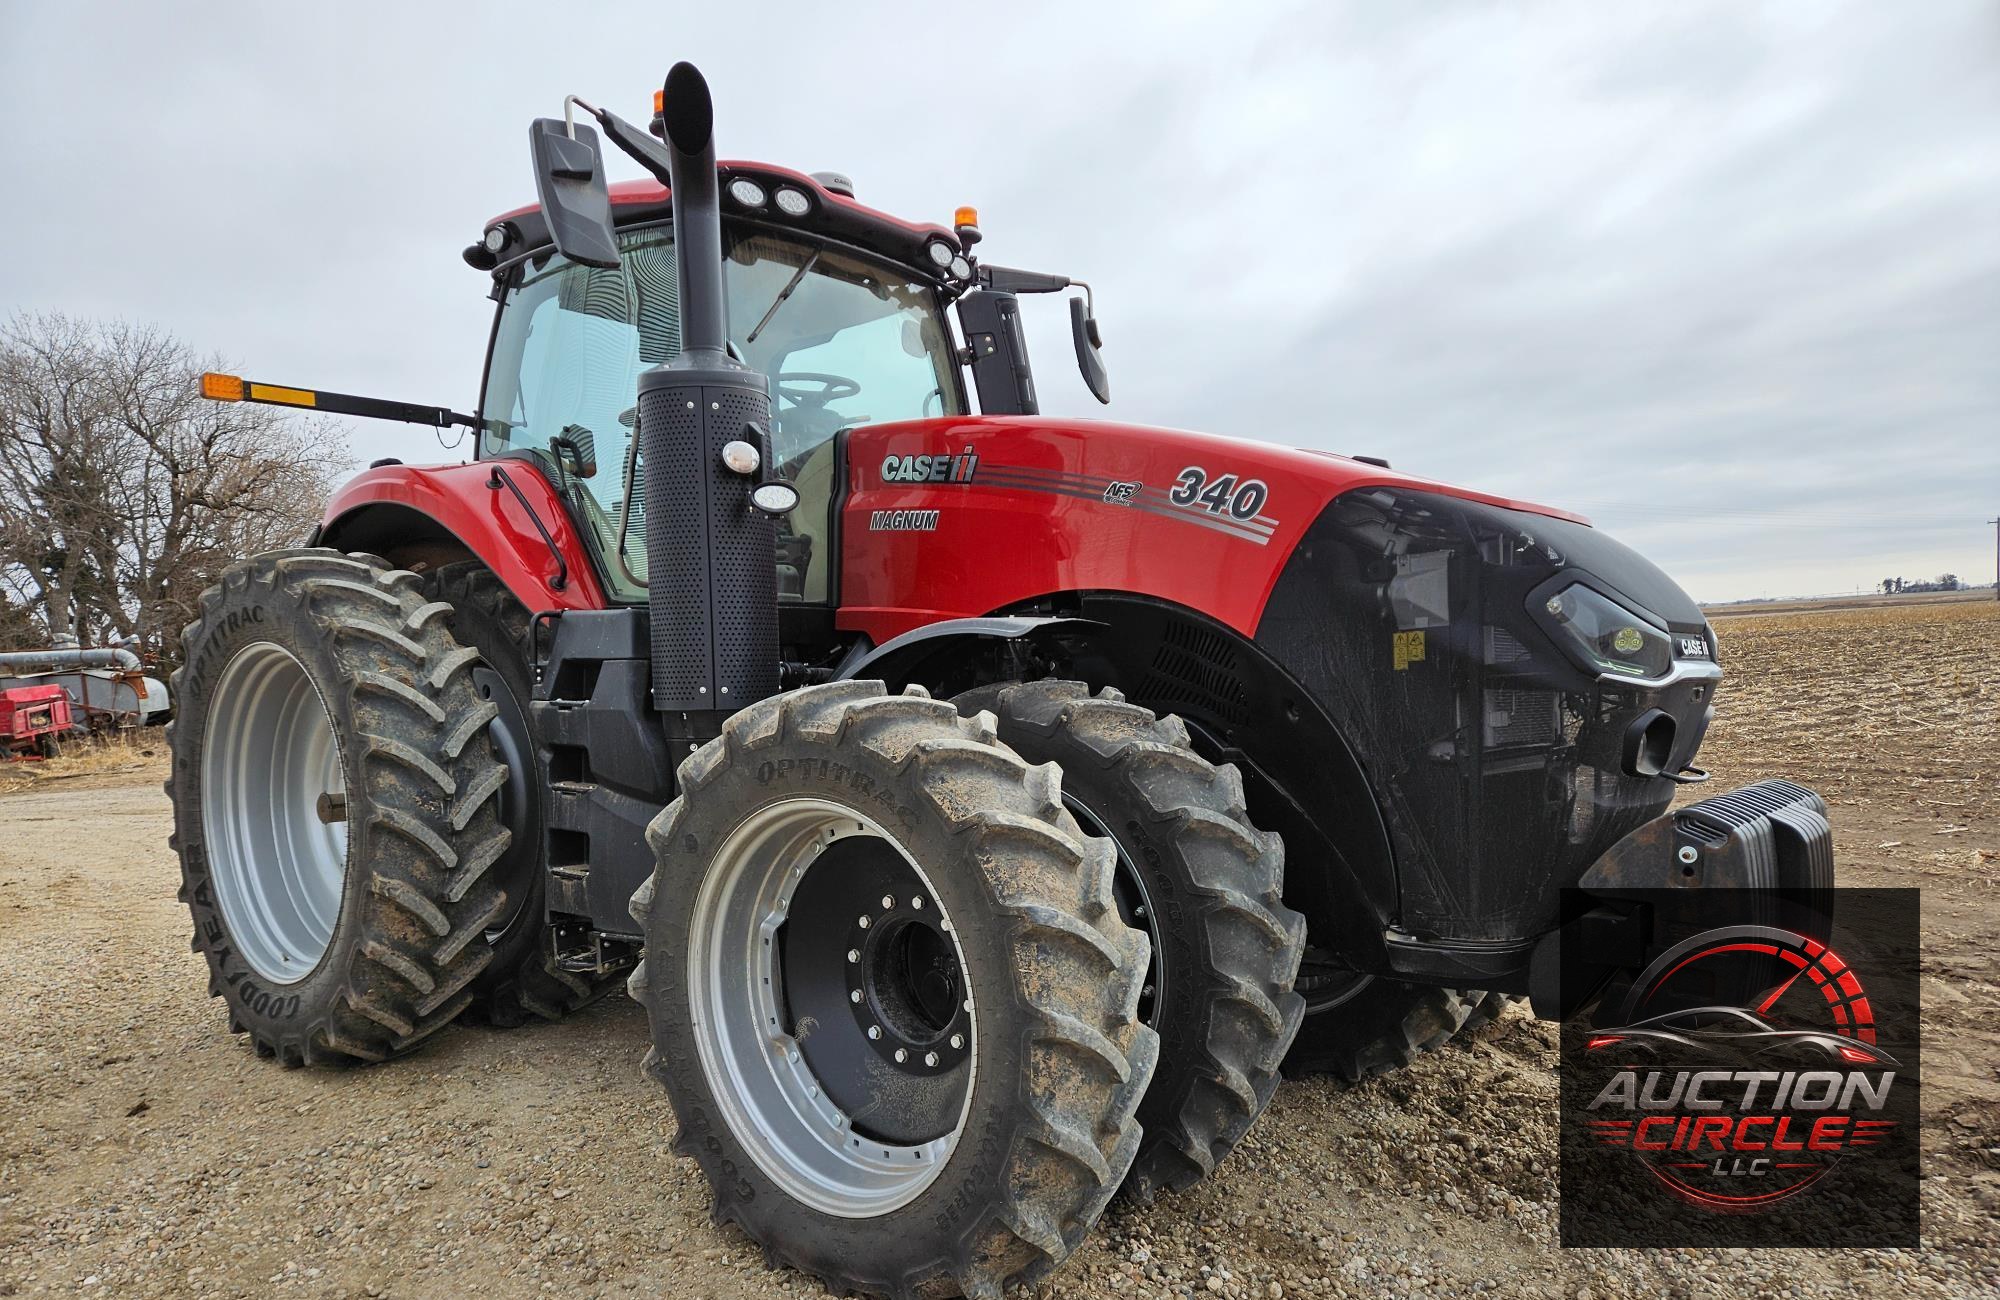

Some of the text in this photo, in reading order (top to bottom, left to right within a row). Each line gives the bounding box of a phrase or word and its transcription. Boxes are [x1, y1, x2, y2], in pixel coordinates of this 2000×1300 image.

[881, 454, 951, 482] CASE
[1104, 481, 1136, 499] AFS
[1169, 465, 1268, 522] 340
[870, 510, 940, 531] MAGNUM
[188, 604, 265, 699] OPTITRAC
[1681, 639, 1702, 656] CASE
[756, 757, 922, 832] OPTITRAC
[185, 843, 300, 1020] GOODYEAR
